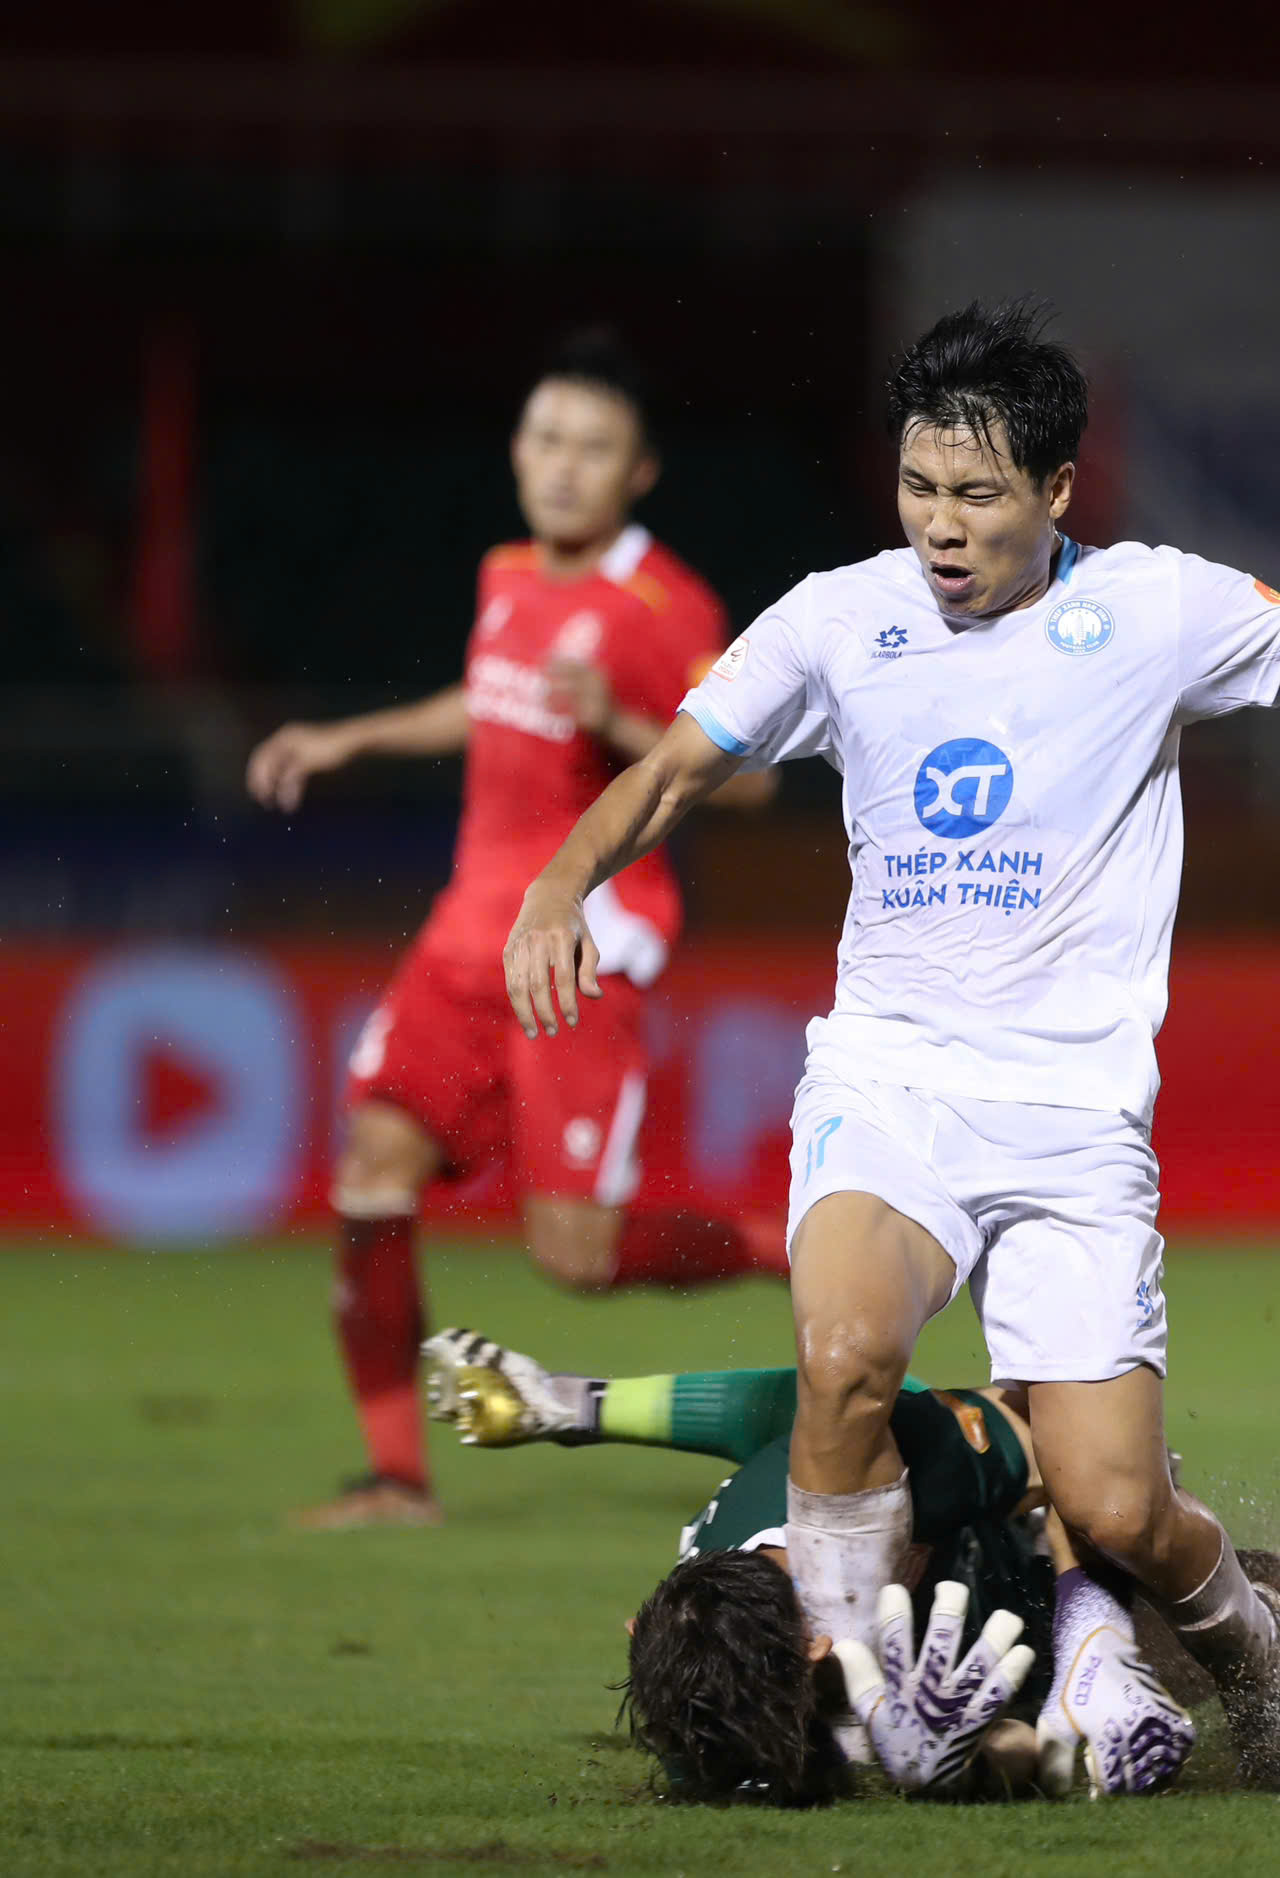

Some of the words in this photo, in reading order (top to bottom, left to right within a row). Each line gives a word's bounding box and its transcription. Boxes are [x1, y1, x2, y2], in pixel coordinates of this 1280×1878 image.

[884, 846, 947, 877] THÉP
[955, 850, 1043, 876] XANH
[957, 879, 1042, 916] THIỆN
